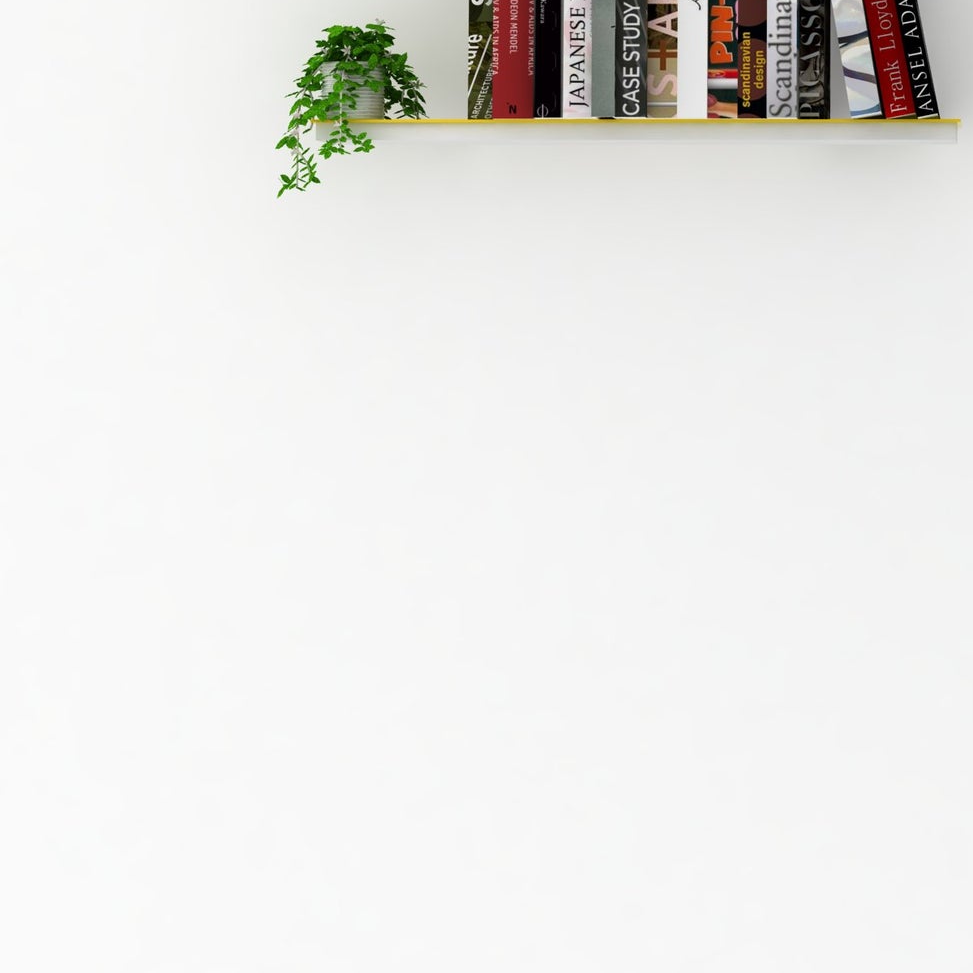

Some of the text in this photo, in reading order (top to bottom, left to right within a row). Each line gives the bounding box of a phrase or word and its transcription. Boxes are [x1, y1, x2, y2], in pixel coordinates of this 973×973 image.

[509, 22, 518, 54] MENDEL
[623, 2, 641, 61] STUDY
[872, 0, 896, 52] Lloyd
[569, 7, 589, 107] JAPANESE
[742, 31, 751, 108] scandinavian
[753, 50, 766, 89] design
[907, 46, 934, 112] ANSEL
[622, 66, 641, 115] CASE
[884, 59, 908, 114] Frank
